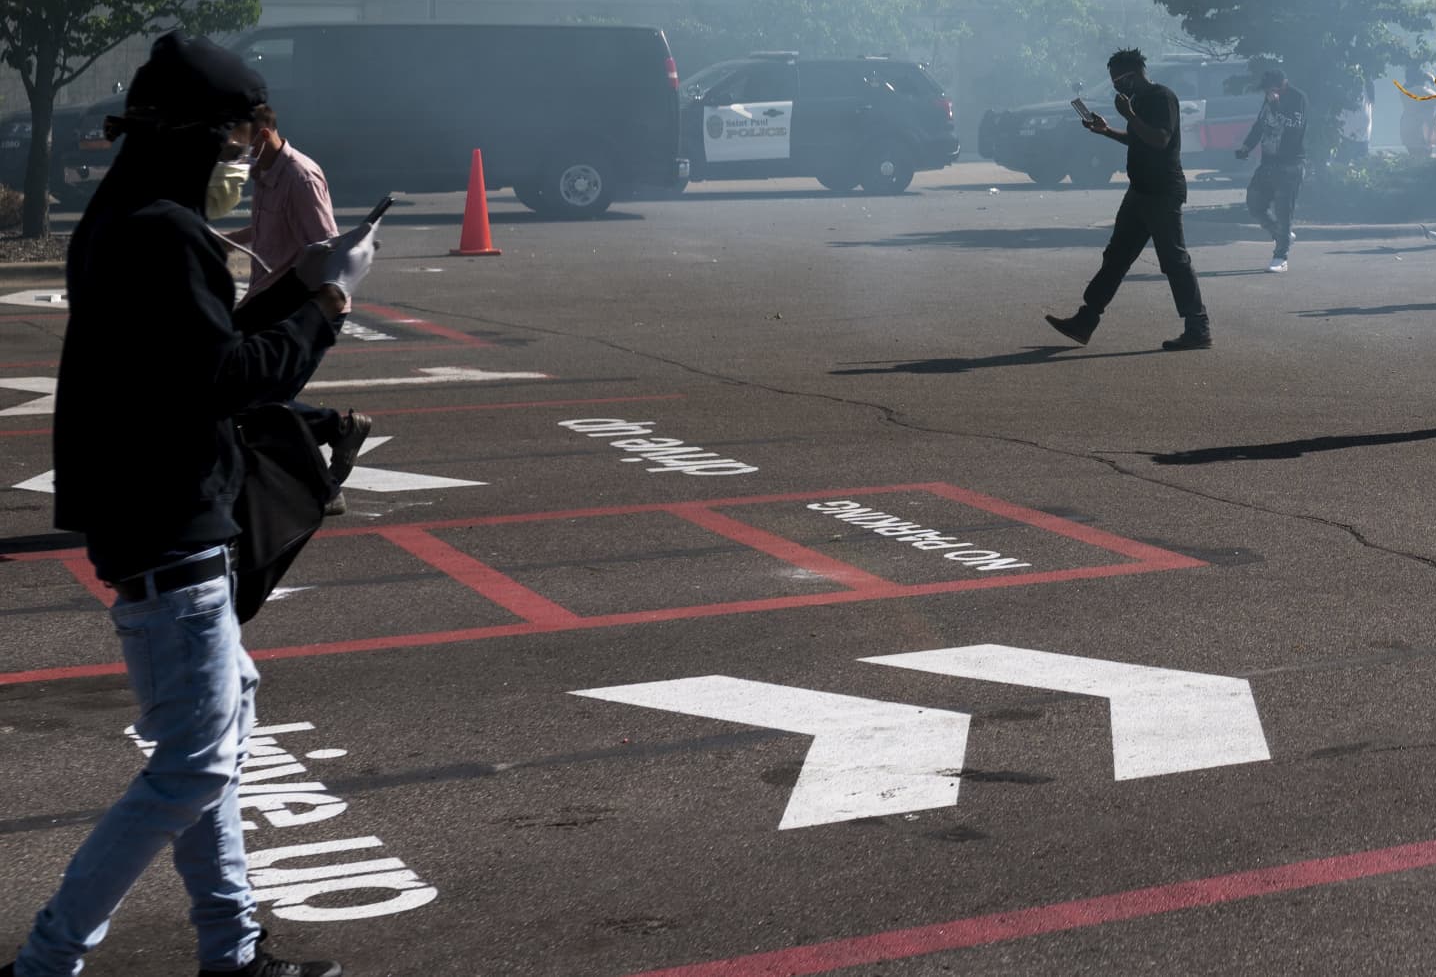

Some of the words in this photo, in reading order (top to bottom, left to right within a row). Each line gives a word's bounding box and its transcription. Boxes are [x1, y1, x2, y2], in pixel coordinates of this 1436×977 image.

[726, 127, 787, 139] POLICE
[557, 418, 657, 438] up
[609, 437, 760, 475] drive
[806, 500, 974, 551] PARKING
[943, 549, 1033, 571] NO
[246, 835, 439, 922] up
